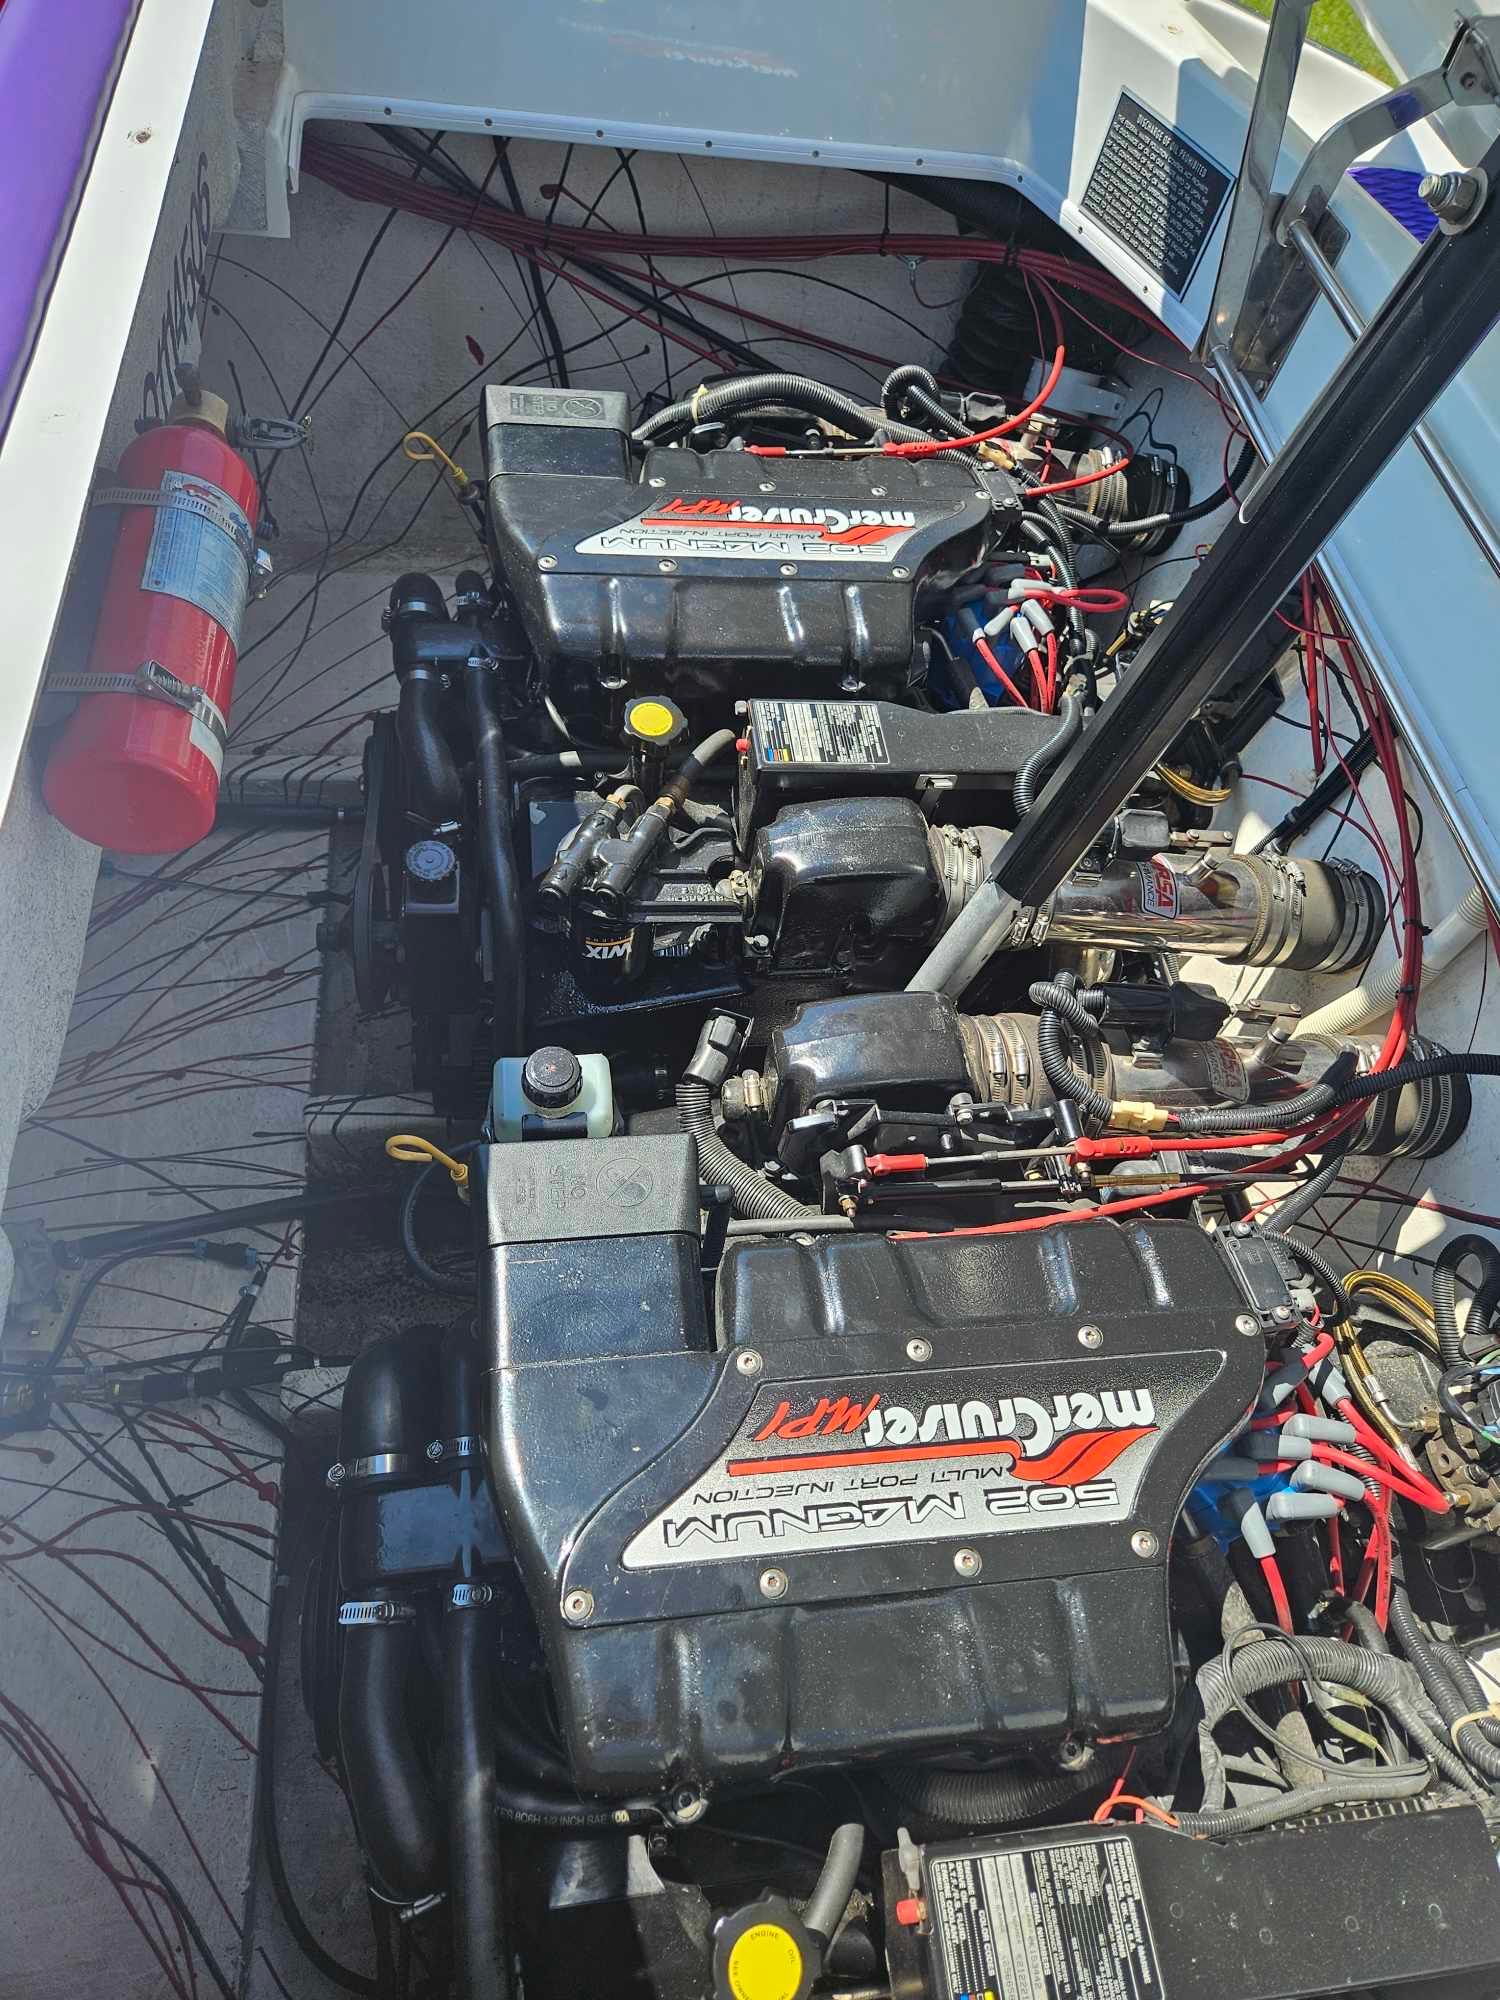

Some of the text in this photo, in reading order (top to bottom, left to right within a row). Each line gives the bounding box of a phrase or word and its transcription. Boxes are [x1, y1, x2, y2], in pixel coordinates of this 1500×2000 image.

[1161, 134, 1171, 148] OF
[658, 498, 739, 515] MPI
[600, 536, 887, 557] 502 MAGNUM
[585, 944, 632, 960] WIX
[751, 1387, 1155, 1457] merCruiser MPI
[692, 1465, 1004, 1506] MULTI PORT INJECTION
[663, 1482, 1119, 1548] 502 MAGNUM
[954, 1860, 968, 1904] DRIVE OIL
[962, 1859, 978, 1911] ENGINE OIL
[1113, 1841, 1129, 1881] DIVISION
[1122, 1882, 1133, 1896] OF
[939, 1862, 959, 1944] ENGINE COOLANT
[750, 1929, 796, 1965] ENGINE OIL
[955, 1912, 966, 1940] FLUID
[977, 1909, 989, 1942] COLOR
[983, 1942, 995, 1976] CODES
[1029, 1891, 1051, 1975] SERIAL NUMBERS
